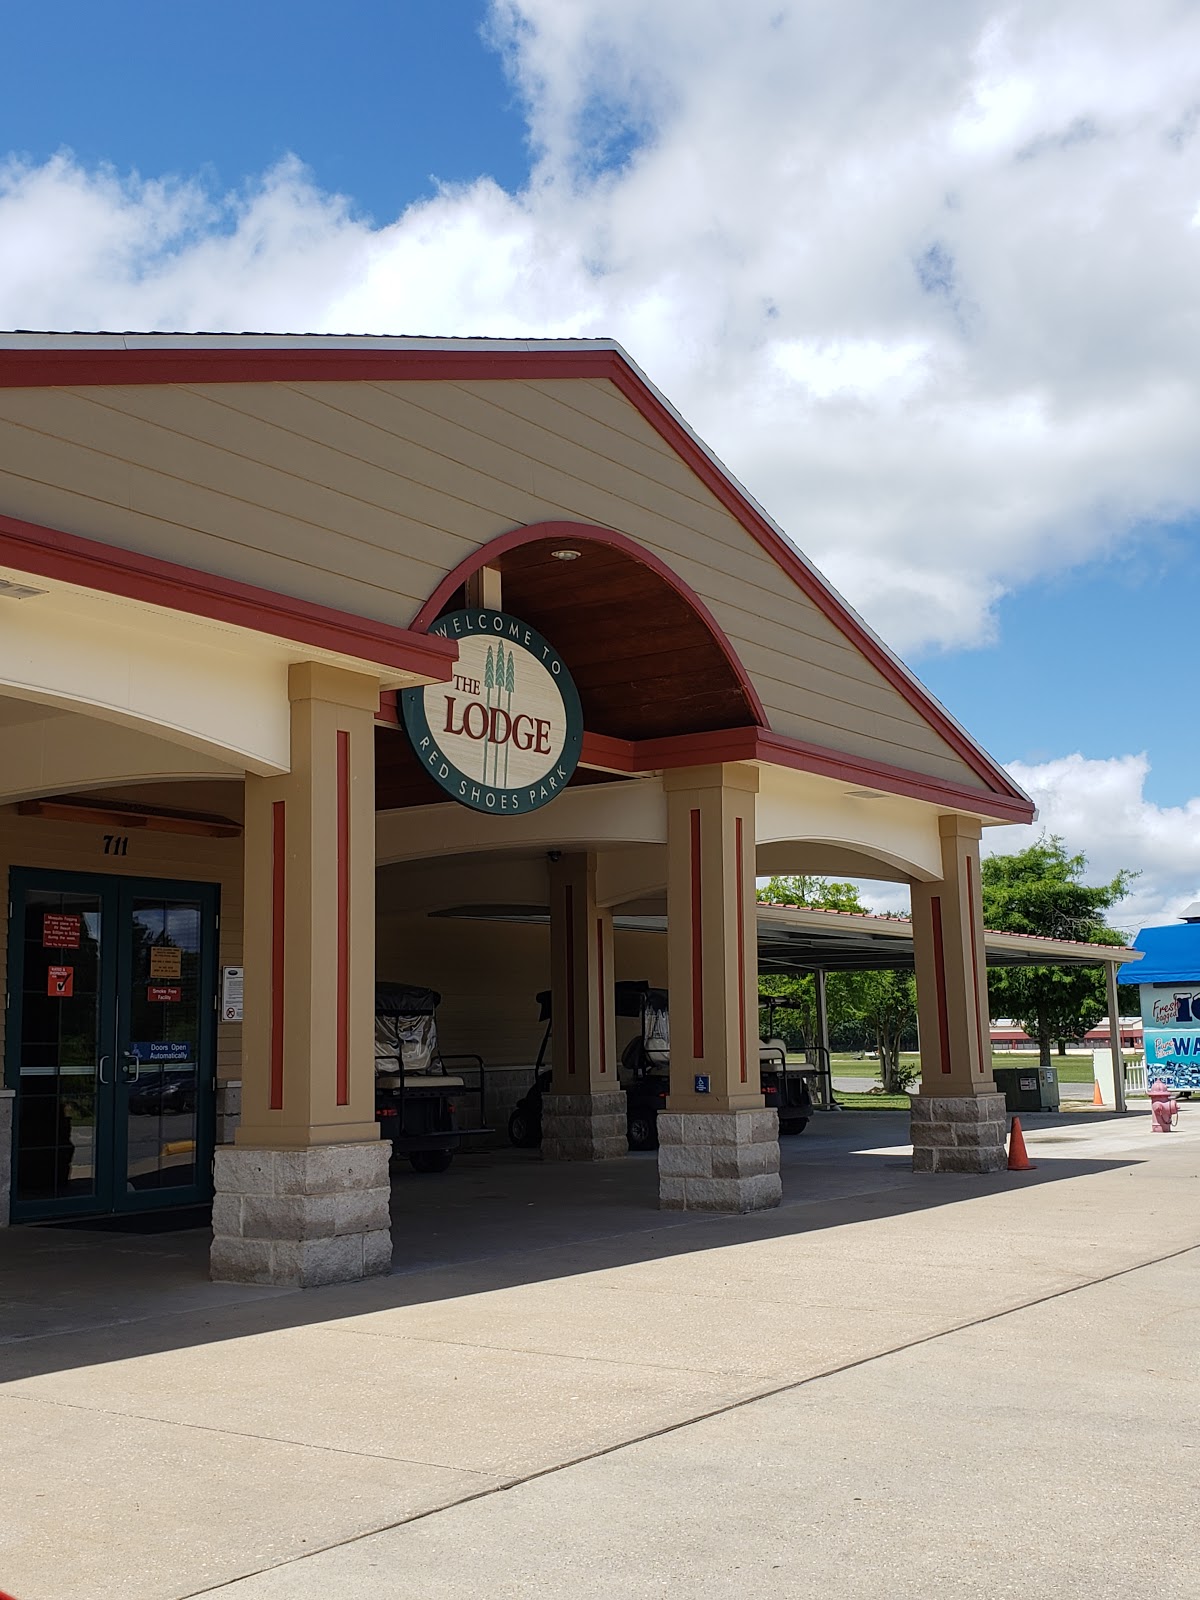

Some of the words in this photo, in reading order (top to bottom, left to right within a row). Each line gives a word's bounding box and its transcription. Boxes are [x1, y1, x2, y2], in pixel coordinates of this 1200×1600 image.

[435, 614, 532, 646] WELCOME
[542, 646, 561, 675] TO
[453, 674, 481, 695] THE
[443, 695, 552, 755] LODGE
[419, 736, 449, 779] RED
[459, 780, 519, 809] SHOES
[529, 764, 567, 804] PARK
[103, 835, 128, 856] 711
[1153, 996, 1181, 1017] Fresh
[1156, 1010, 1178, 1025] bagged
